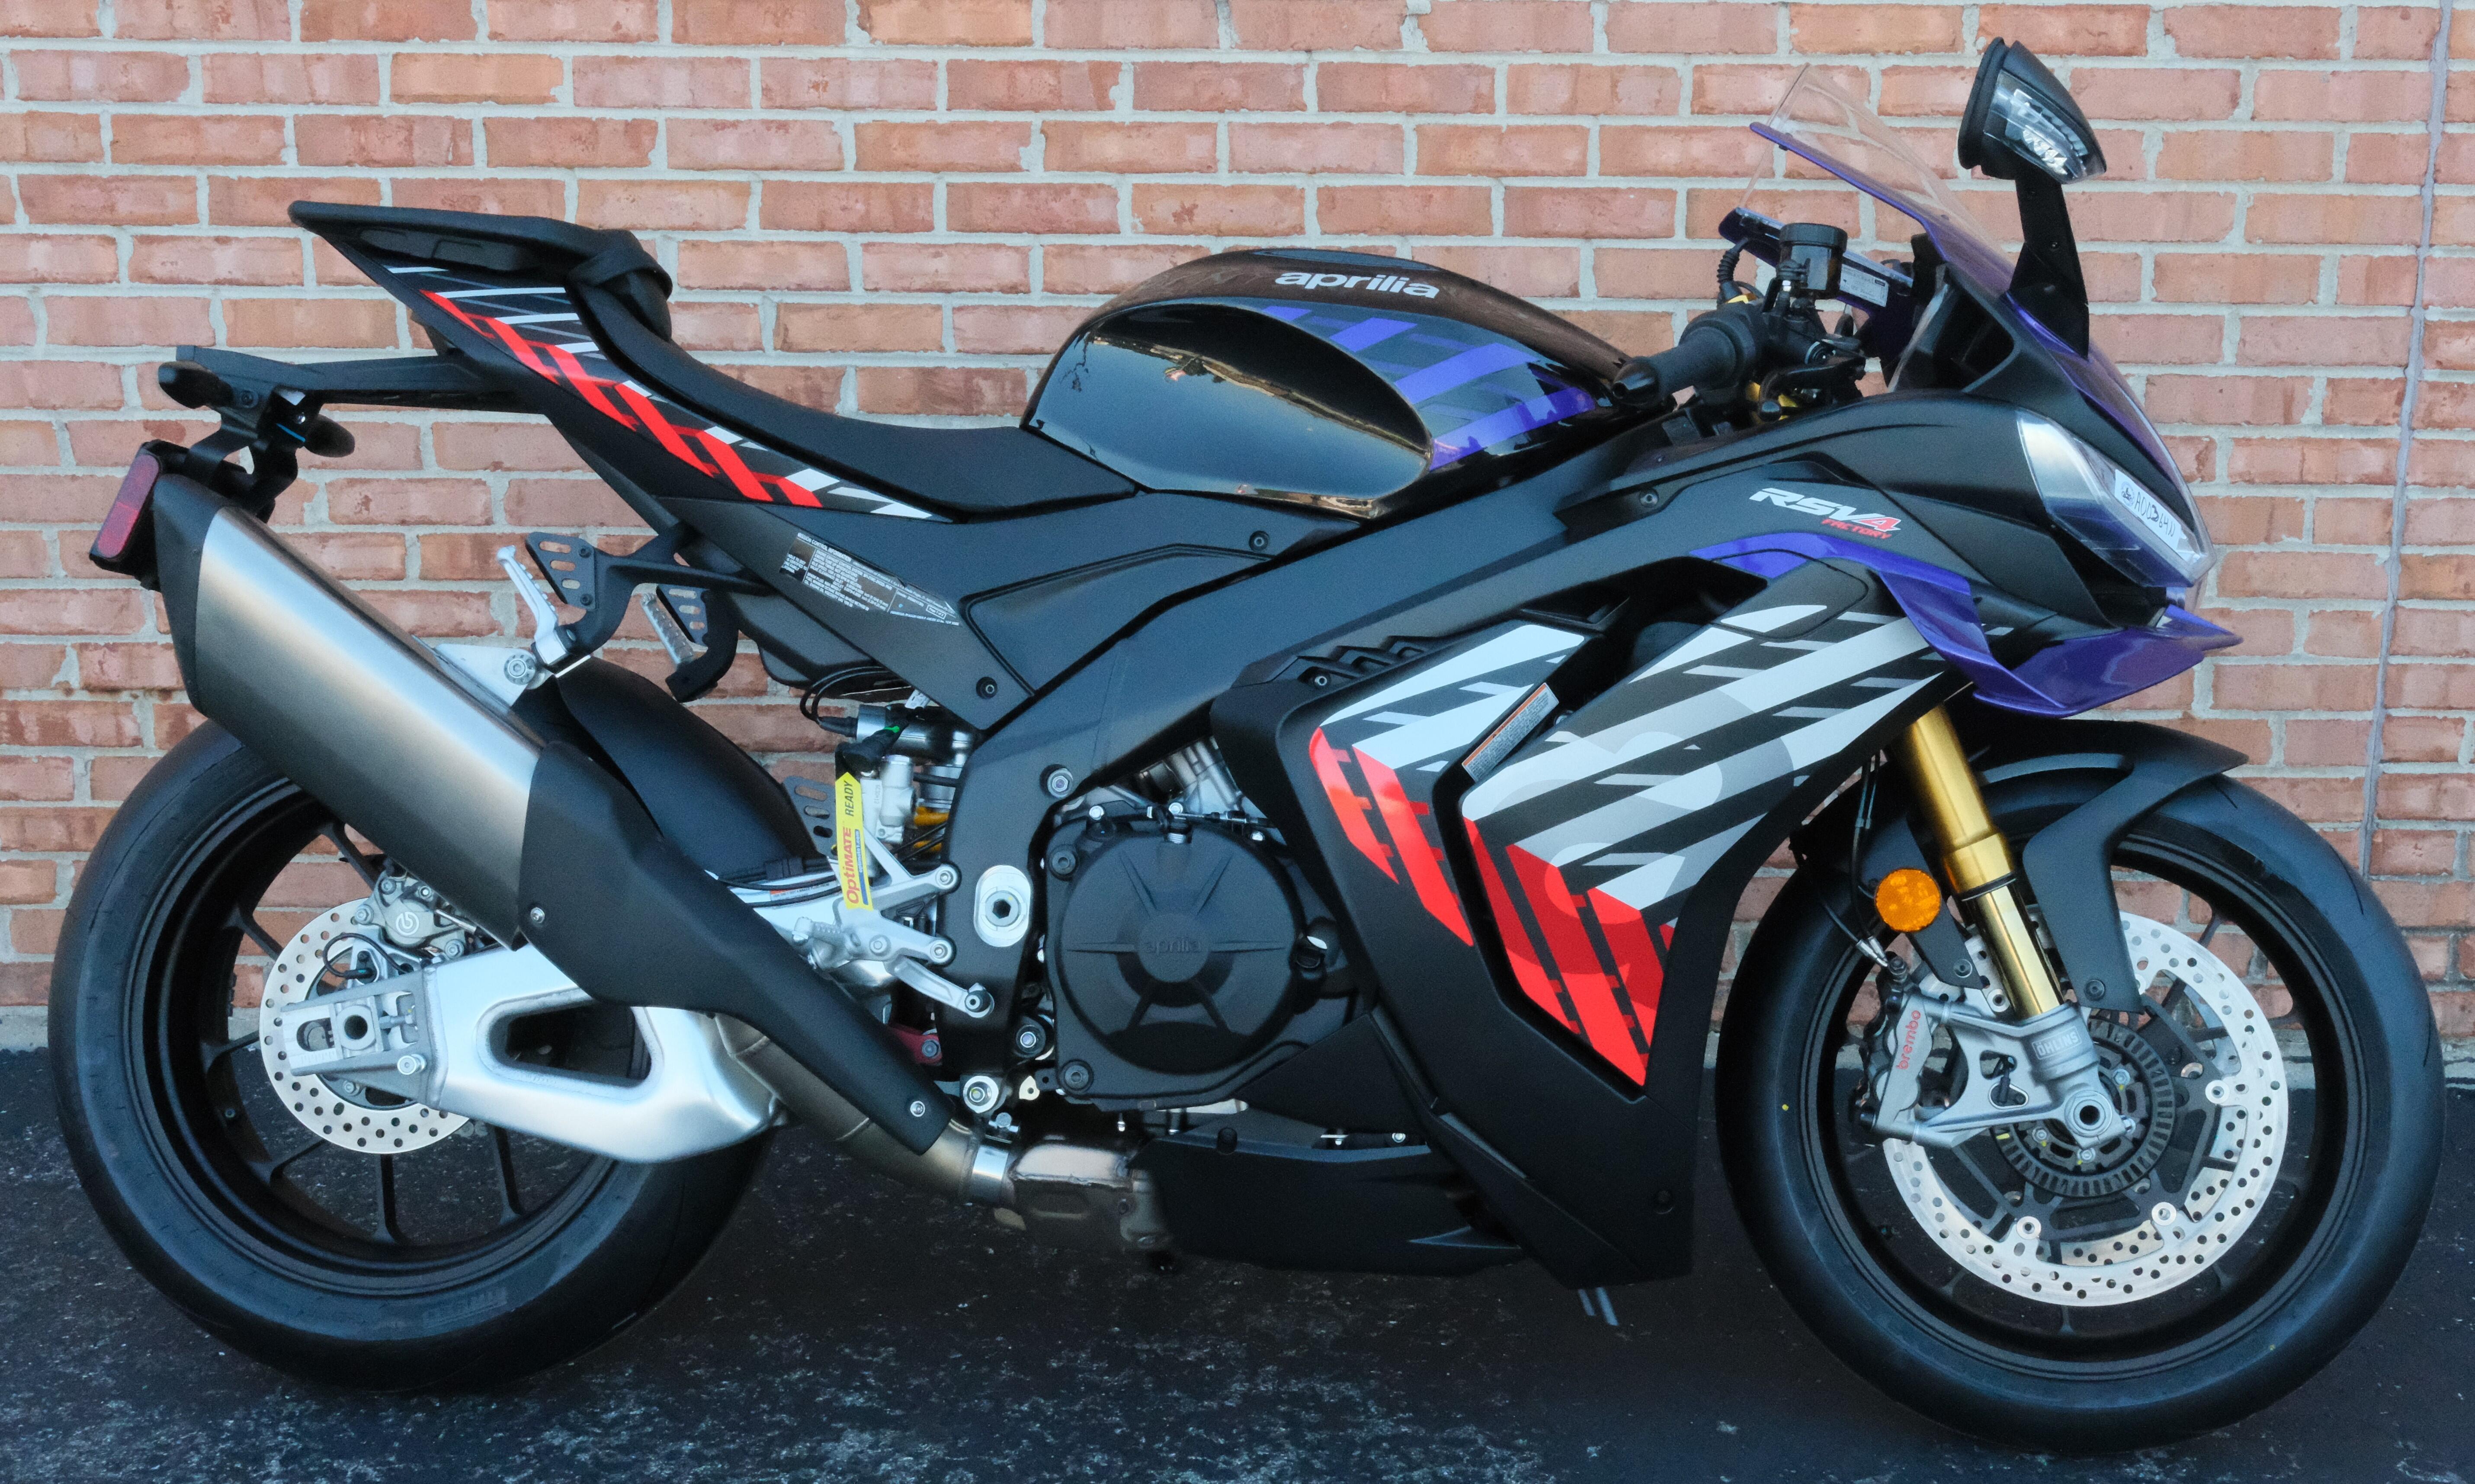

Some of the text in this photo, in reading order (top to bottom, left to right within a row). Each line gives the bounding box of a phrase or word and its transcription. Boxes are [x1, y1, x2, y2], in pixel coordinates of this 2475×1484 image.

[1275, 272, 1440, 299] aprilia
[1749, 487, 1901, 532] RSV4
[842, 780, 859, 904] OptiMATE READY
[1896, 1010, 1920, 1070] brembo
[2036, 1032, 2079, 1056] ÖHLINS
